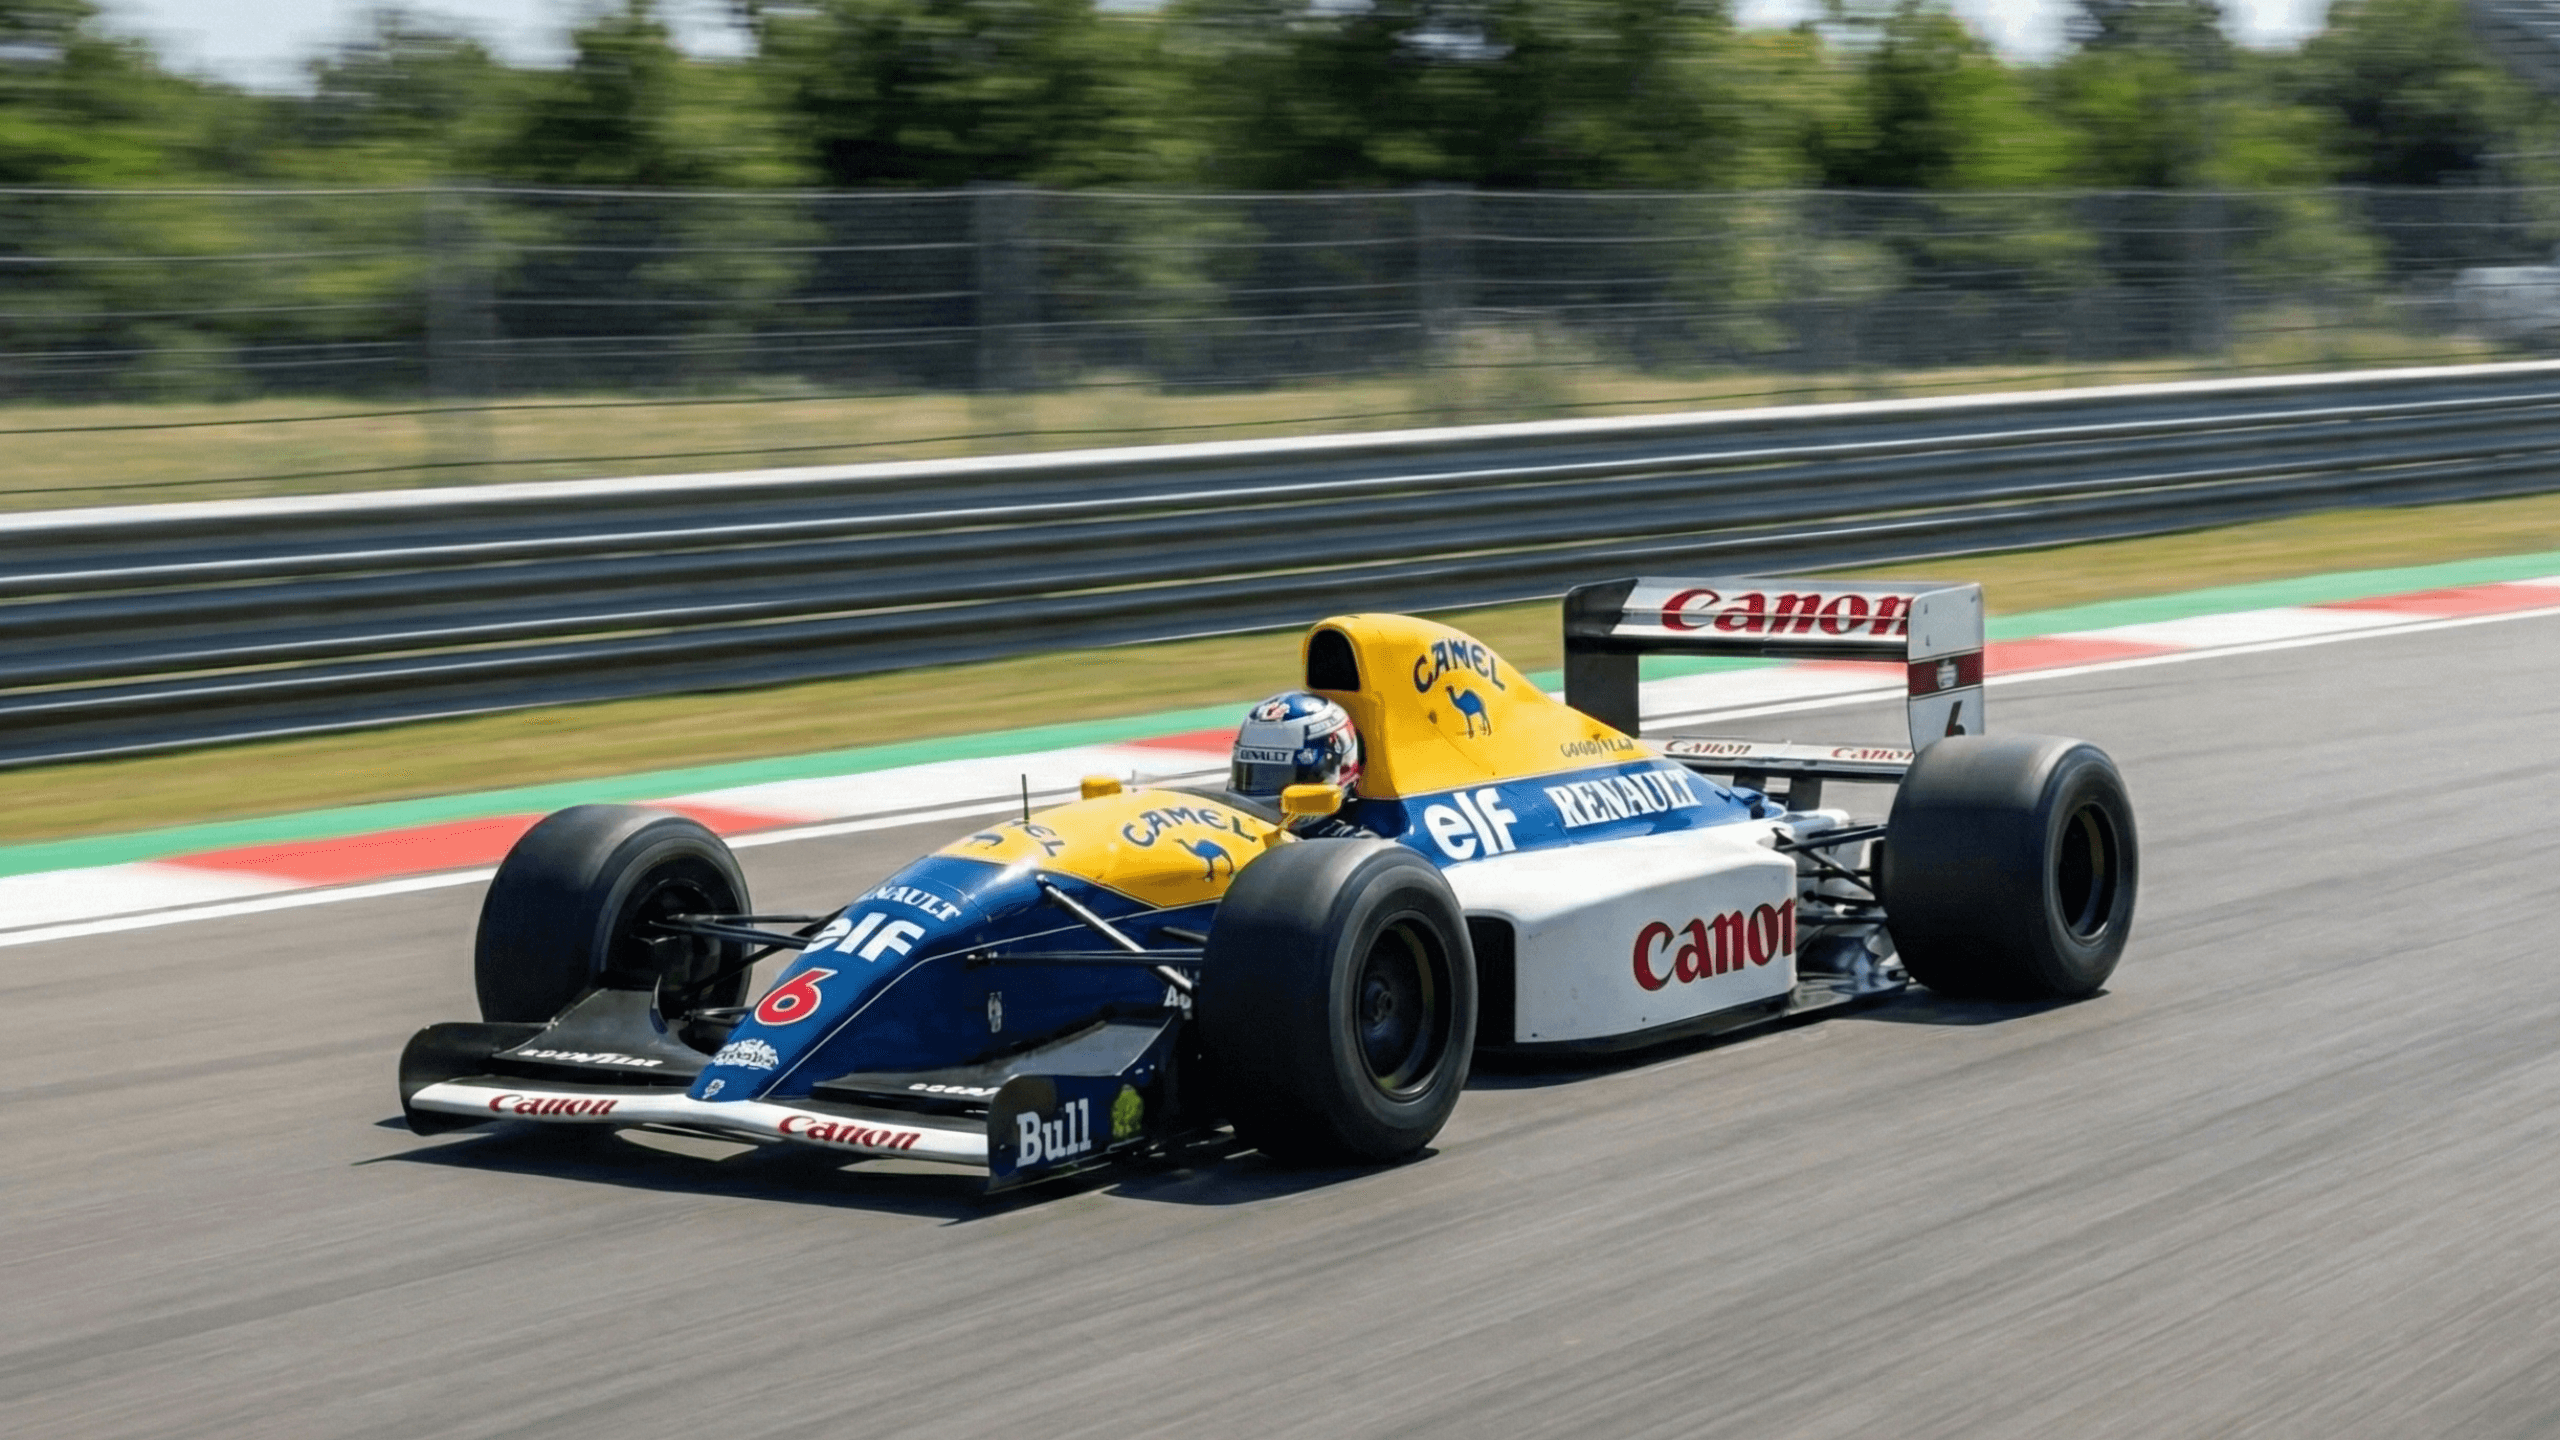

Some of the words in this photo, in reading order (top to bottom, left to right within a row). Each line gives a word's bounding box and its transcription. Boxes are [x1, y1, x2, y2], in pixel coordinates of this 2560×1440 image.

[1662, 588, 1914, 635] Canon
[1413, 638, 1505, 693] CAMEL
[1424, 787, 1518, 860] elf
[1543, 769, 1702, 828] RENAULT
[1122, 806, 1258, 847] CAMEL
[802, 911, 926, 963] elf
[754, 967, 838, 1026] 6
[489, 1094, 618, 1116] Canon
[777, 1115, 922, 1150] Canon
[1015, 1098, 1091, 1168] Bull
